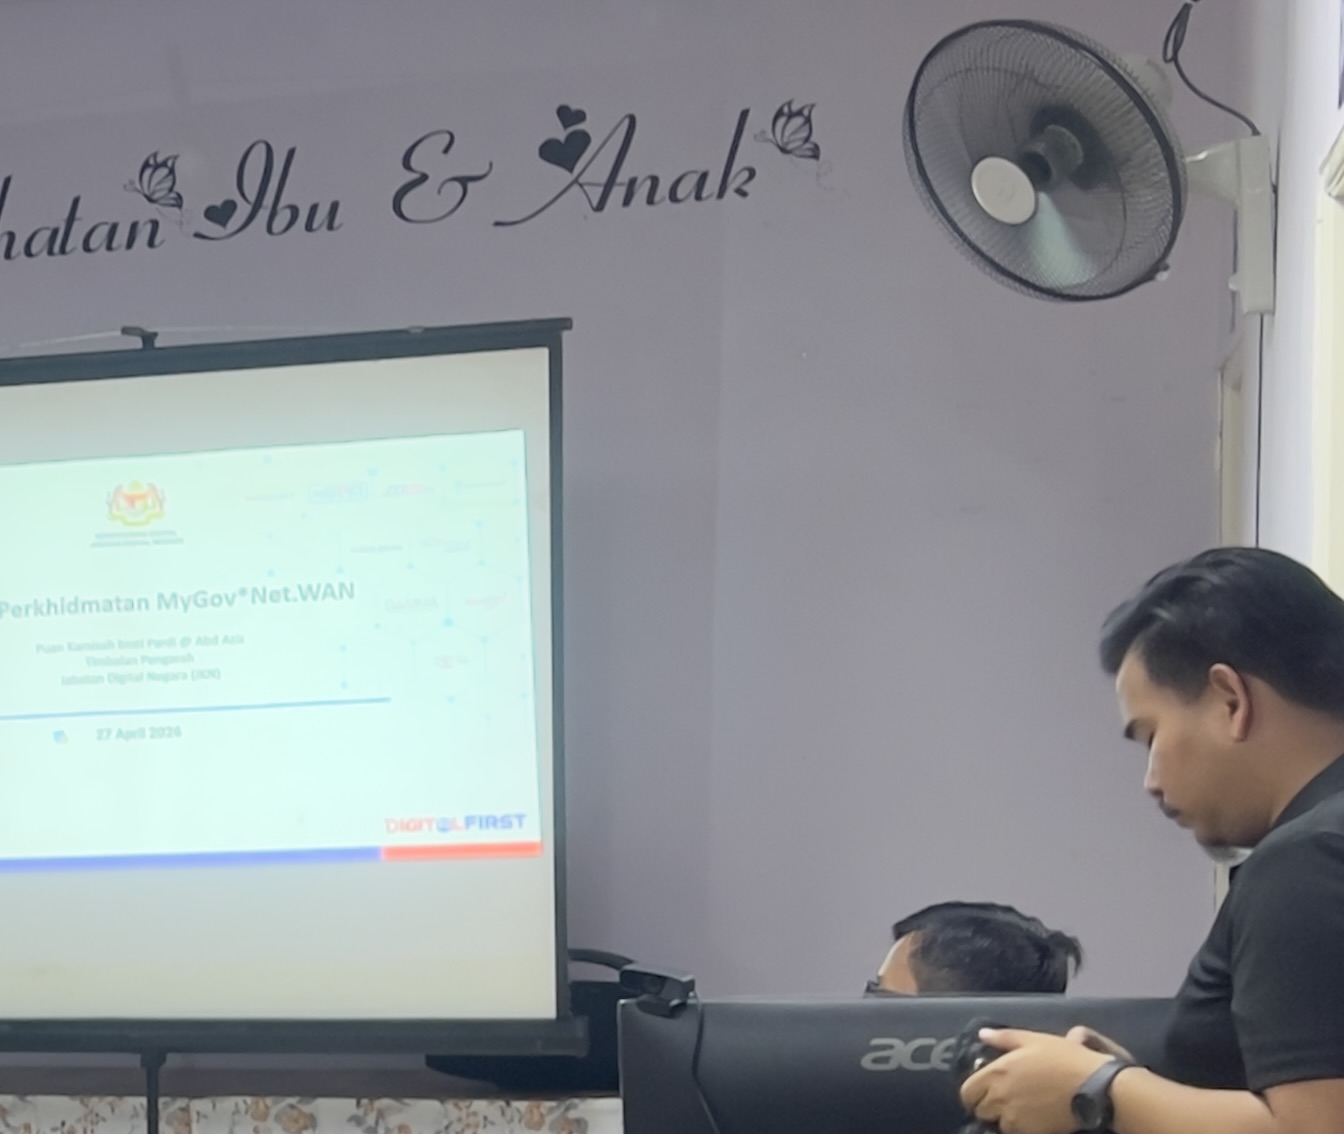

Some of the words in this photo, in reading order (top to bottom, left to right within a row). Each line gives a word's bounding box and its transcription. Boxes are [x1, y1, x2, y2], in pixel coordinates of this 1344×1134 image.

[193, 138, 343, 241] Ibu
[391, 129, 494, 225] &
[493, 107, 758, 227] Anak
[115, 727, 146, 742] April
[860, 1037, 957, 1072] ace
